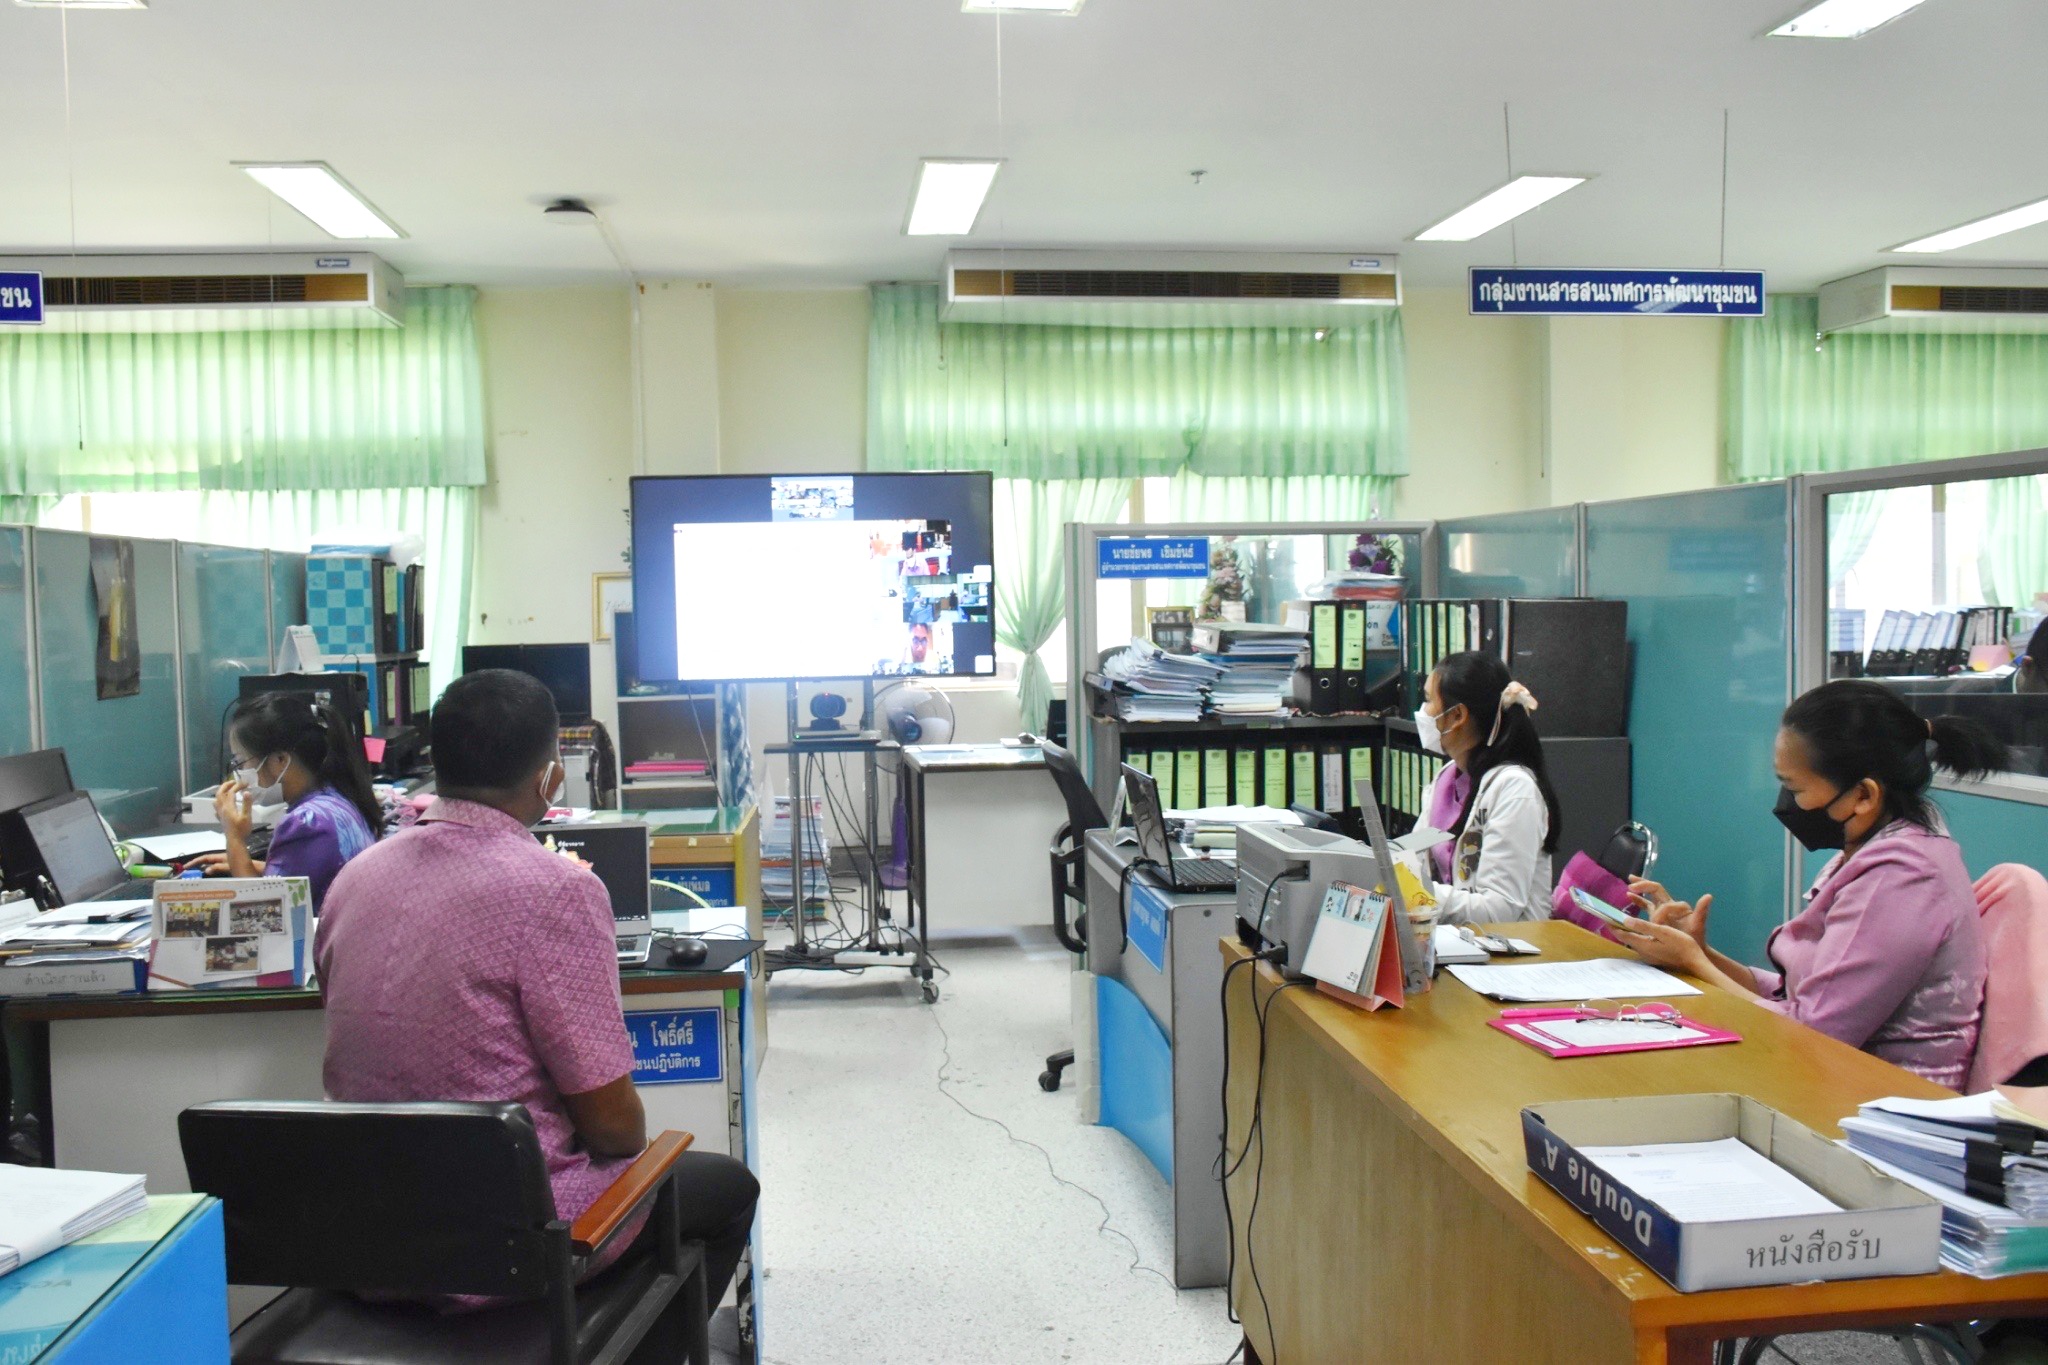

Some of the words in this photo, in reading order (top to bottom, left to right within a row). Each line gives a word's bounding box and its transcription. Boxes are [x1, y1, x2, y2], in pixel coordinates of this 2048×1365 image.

[0, 286, 32, 308] ชน
[1478, 276, 1758, 311] กลุ่มงานสารสนเทศการพัฒนาชุมชน
[650, 1016, 694, 1047] โพธิ์ศรี
[636, 1053, 701, 1073] ชนปฏิบัติการ
[1567, 1157, 1652, 1247] Double
[1746, 1228, 1880, 1268] หนังสือรับ
